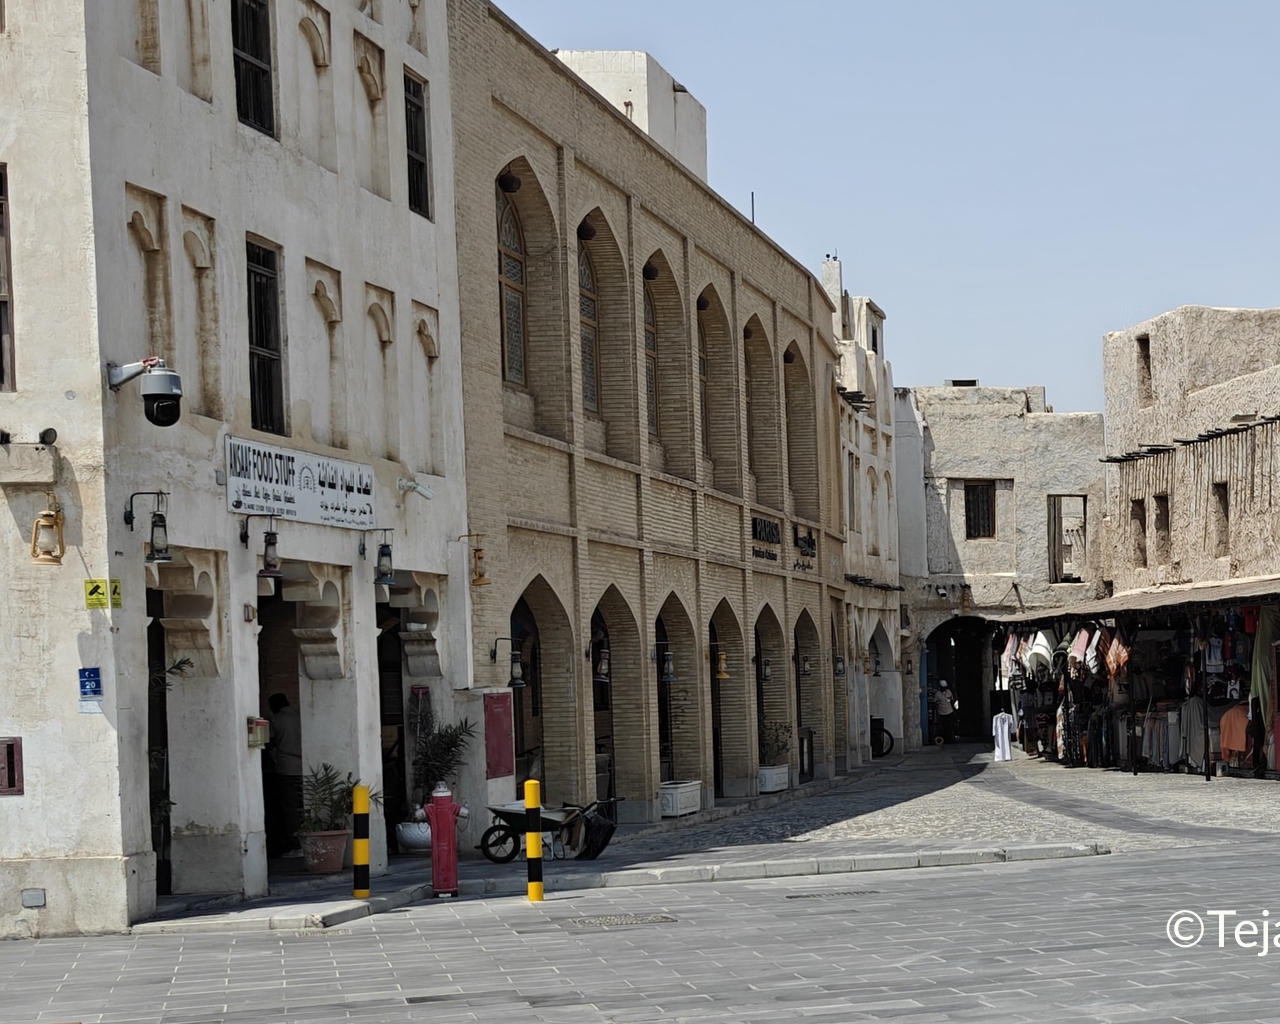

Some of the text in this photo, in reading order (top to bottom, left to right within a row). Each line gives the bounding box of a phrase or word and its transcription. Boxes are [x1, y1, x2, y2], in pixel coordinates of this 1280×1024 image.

[252, 449, 274, 484] FOOD
[275, 453, 295, 487] STUFF
[752, 517, 780, 544] PARISA
[85, 681, 96, 689] 20
